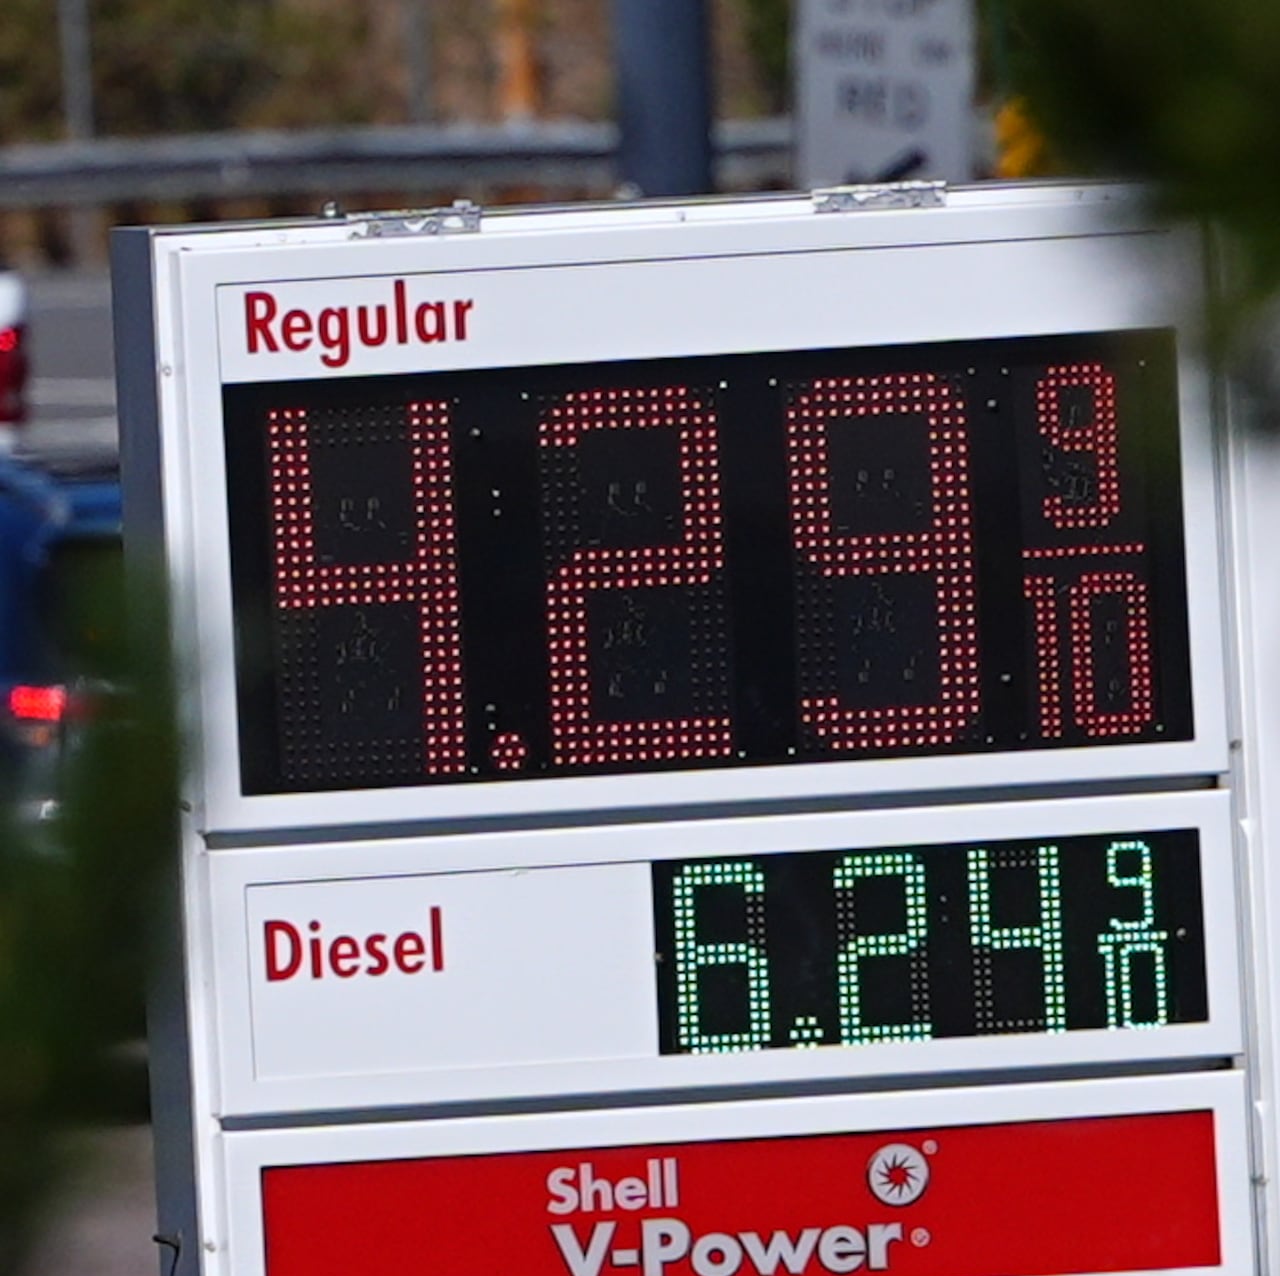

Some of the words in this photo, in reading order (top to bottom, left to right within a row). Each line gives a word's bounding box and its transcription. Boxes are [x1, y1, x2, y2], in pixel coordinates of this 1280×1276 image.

[244, 279, 473, 368] Regular
[263, 905, 443, 982] Diesel
[547, 1157, 679, 1215] Shell
